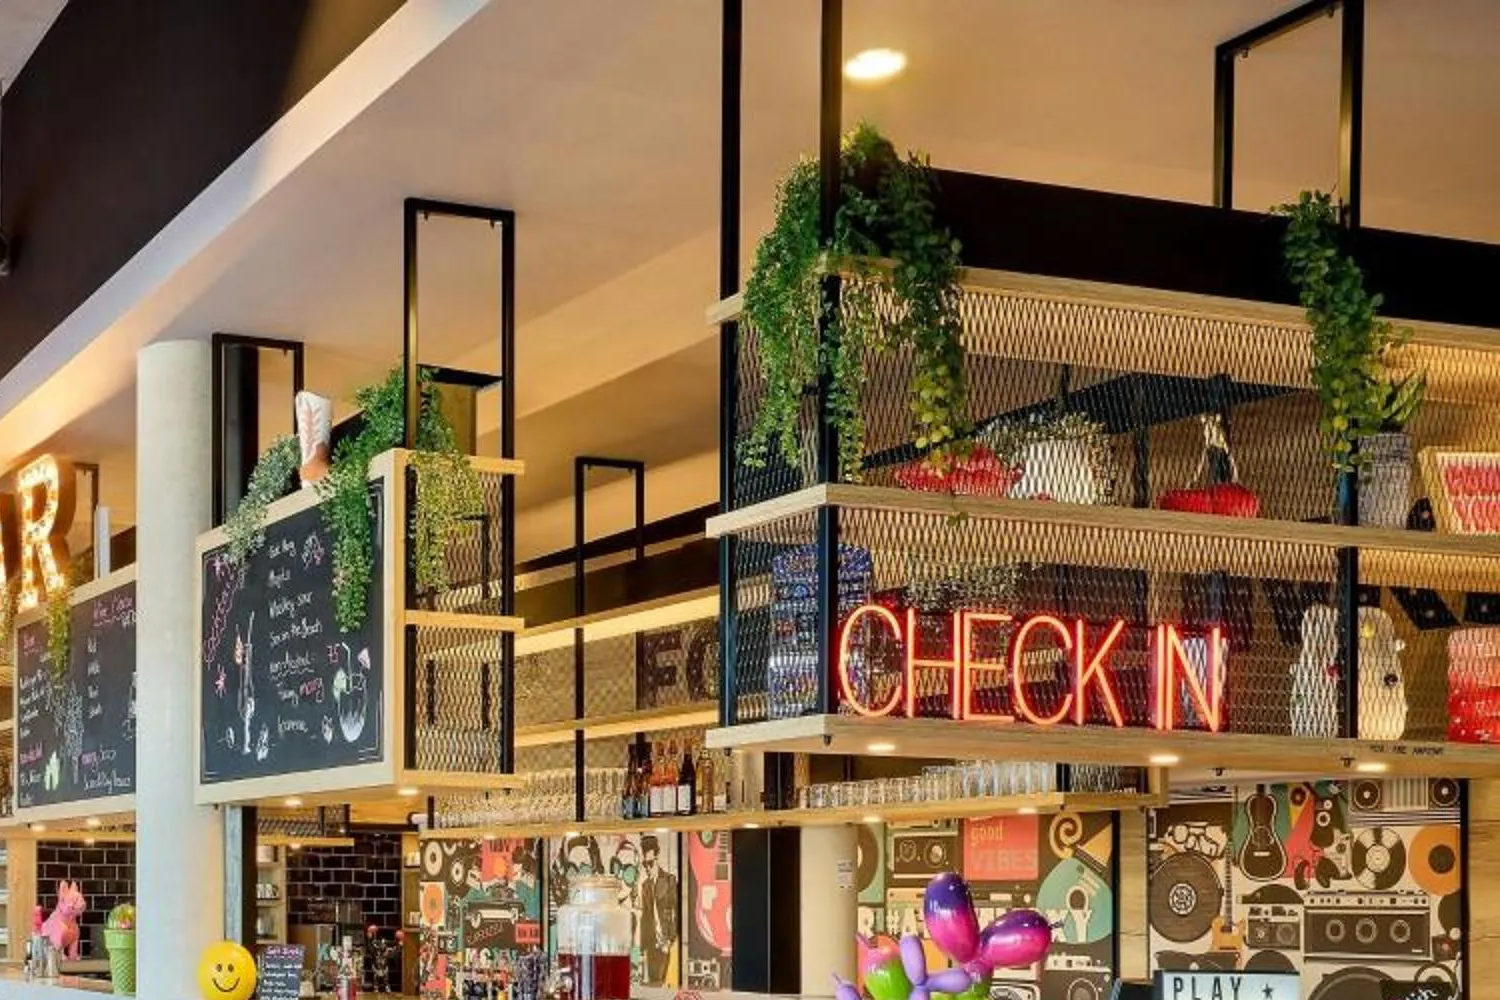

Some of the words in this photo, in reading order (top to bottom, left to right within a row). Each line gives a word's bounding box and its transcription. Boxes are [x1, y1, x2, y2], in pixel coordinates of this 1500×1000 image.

[839, 604, 1124, 728] CHECK
[1155, 624, 1227, 732] IN
[970, 821, 1003, 846] good
[969, 850, 1036, 871] VIBES
